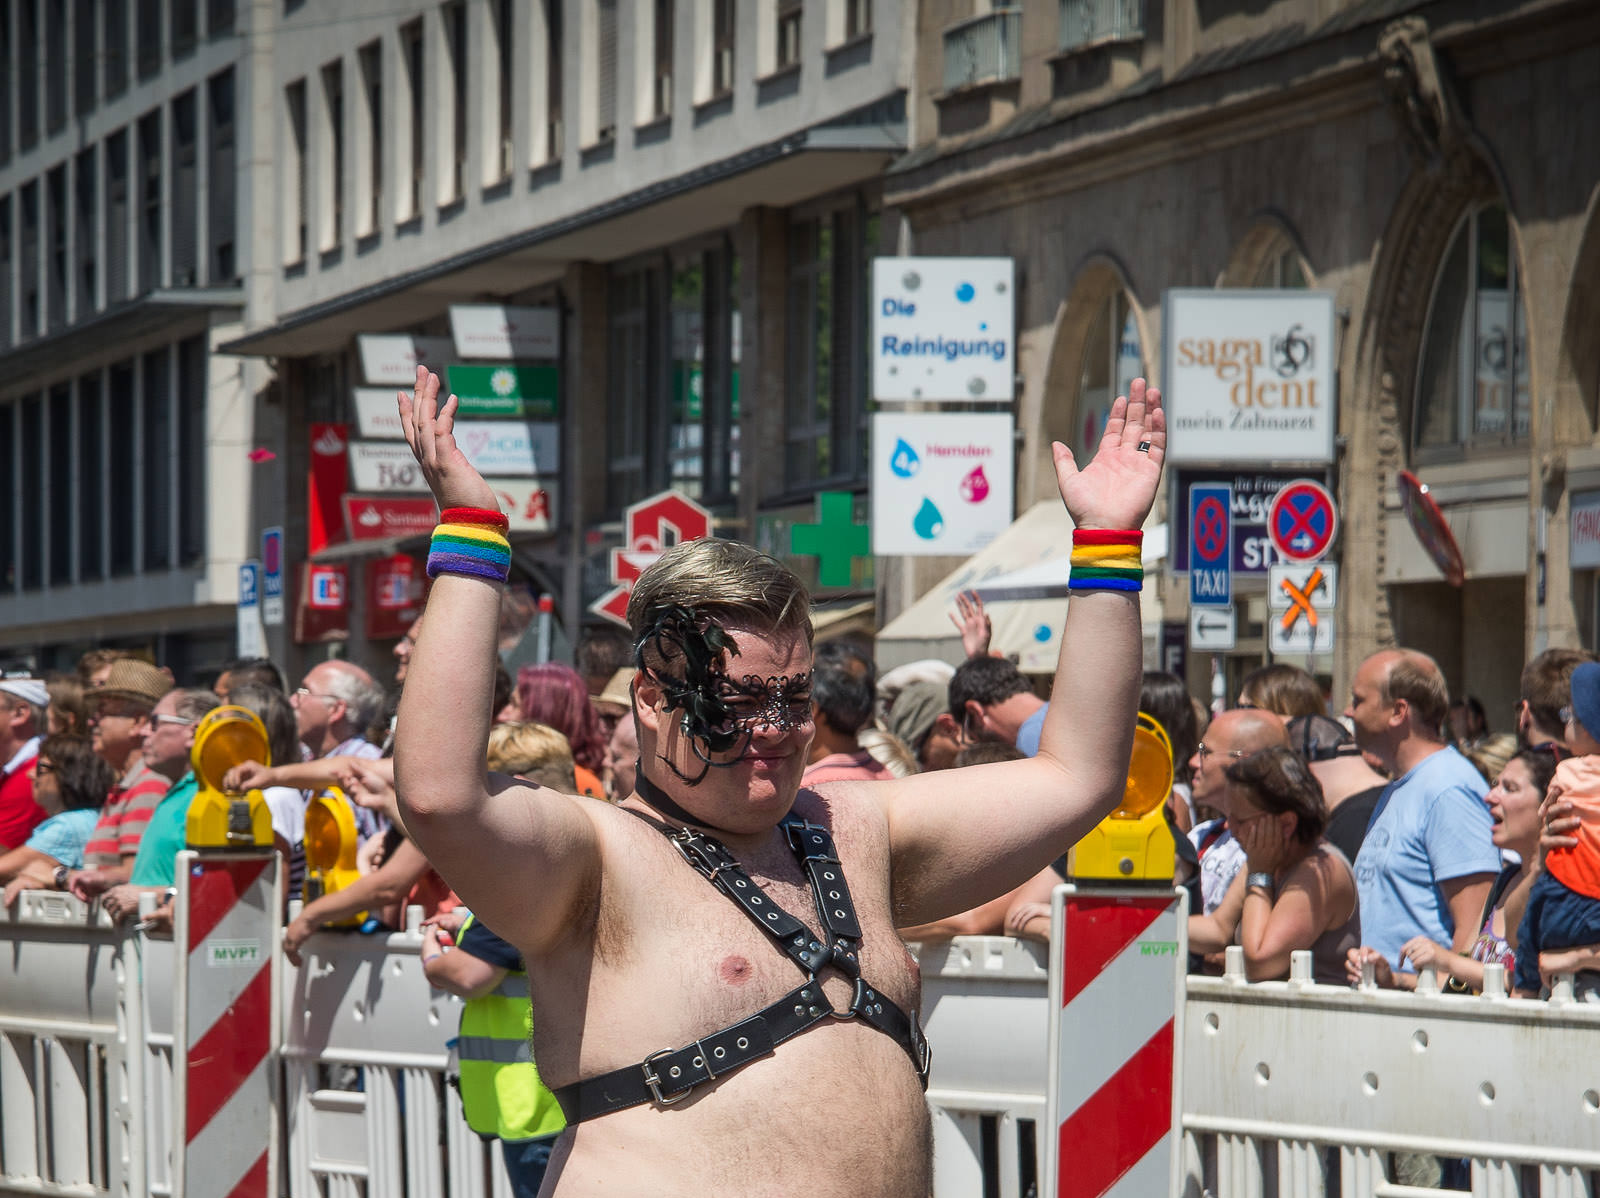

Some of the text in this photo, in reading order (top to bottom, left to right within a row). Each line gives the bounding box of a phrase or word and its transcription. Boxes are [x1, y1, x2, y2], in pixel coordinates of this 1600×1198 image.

[882, 299, 916, 317] Die
[881, 336, 1006, 361] Reinigung
[1177, 337, 1264, 381] saga
[1230, 360, 1320, 409] dent
[1176, 409, 1315, 432] mein Zahnarzt
[926, 444, 992, 457] Hemden
[1194, 570, 1227, 596] TAXI
[213, 946, 257, 959] MVPT
[1140, 944, 1177, 956] MVPT
